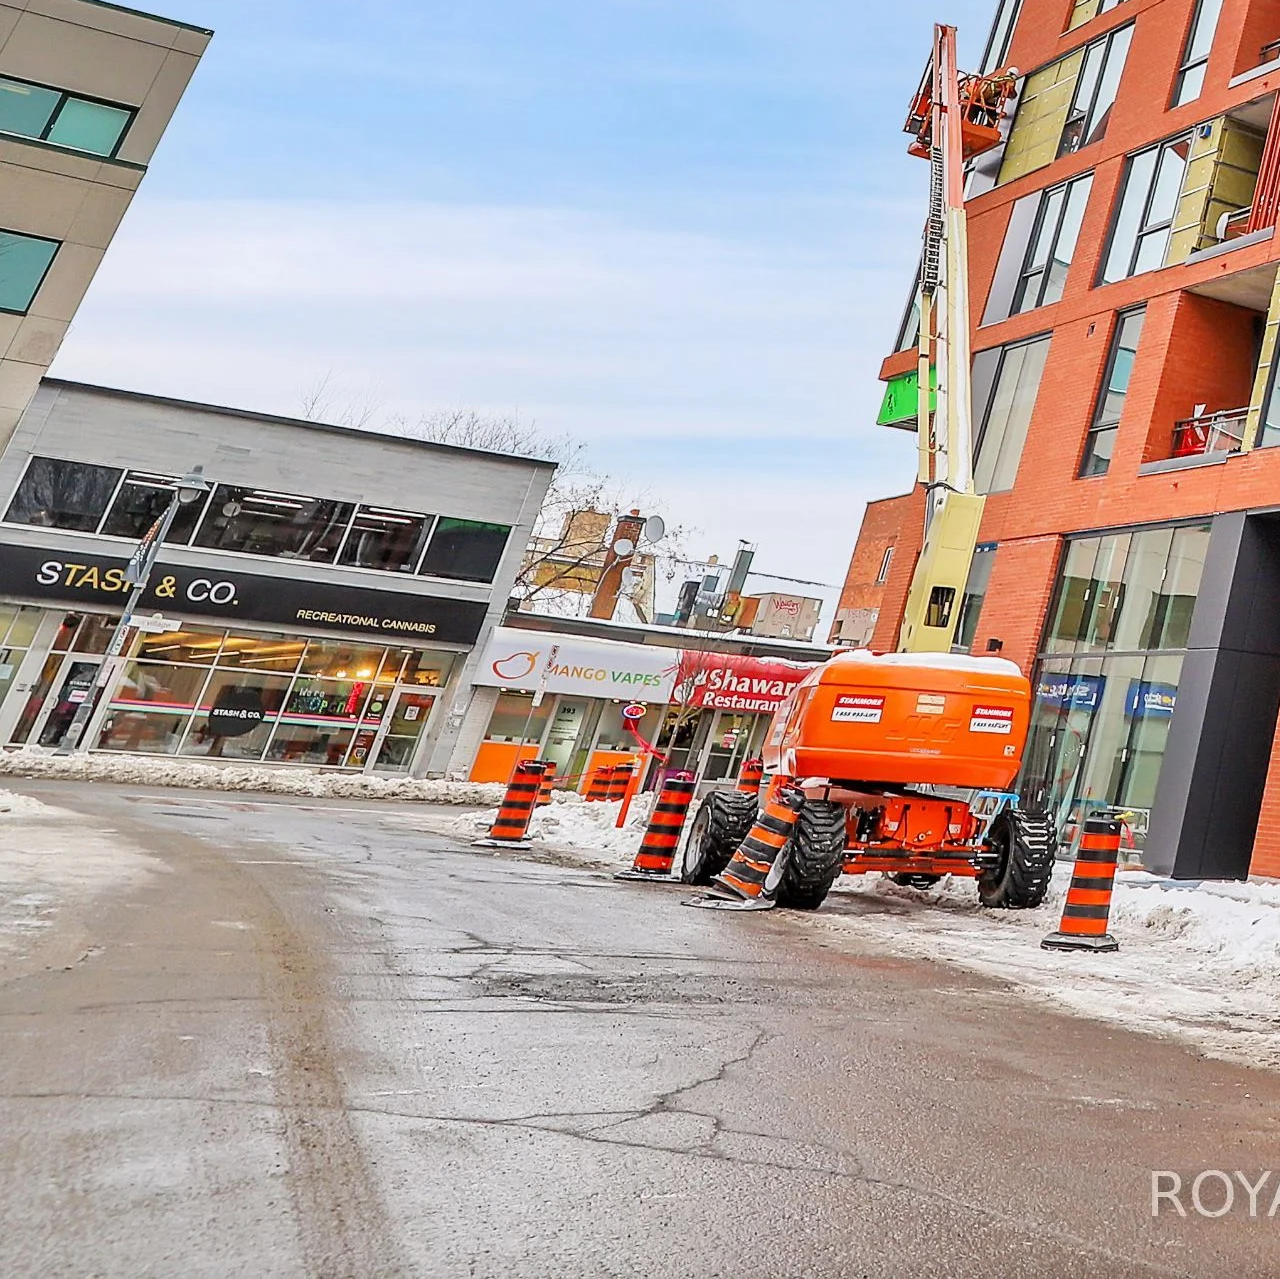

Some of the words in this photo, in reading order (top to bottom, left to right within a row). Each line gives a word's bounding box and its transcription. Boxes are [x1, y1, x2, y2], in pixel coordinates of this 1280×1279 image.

[36, 561, 133, 593] STAS
[155, 575, 176, 598] &
[186, 578, 239, 606] CO.
[296, 609, 379, 628] RECREATIONAL
[382, 619, 436, 634] CANNABIS
[611, 671, 662, 687] VAPES
[707, 669, 801, 697] Shawar
[561, 706, 576, 715] 393
[702, 692, 784, 712] Restauran
[839, 697, 884, 706] STANMORE
[975, 708, 1012, 717] STANMORE
